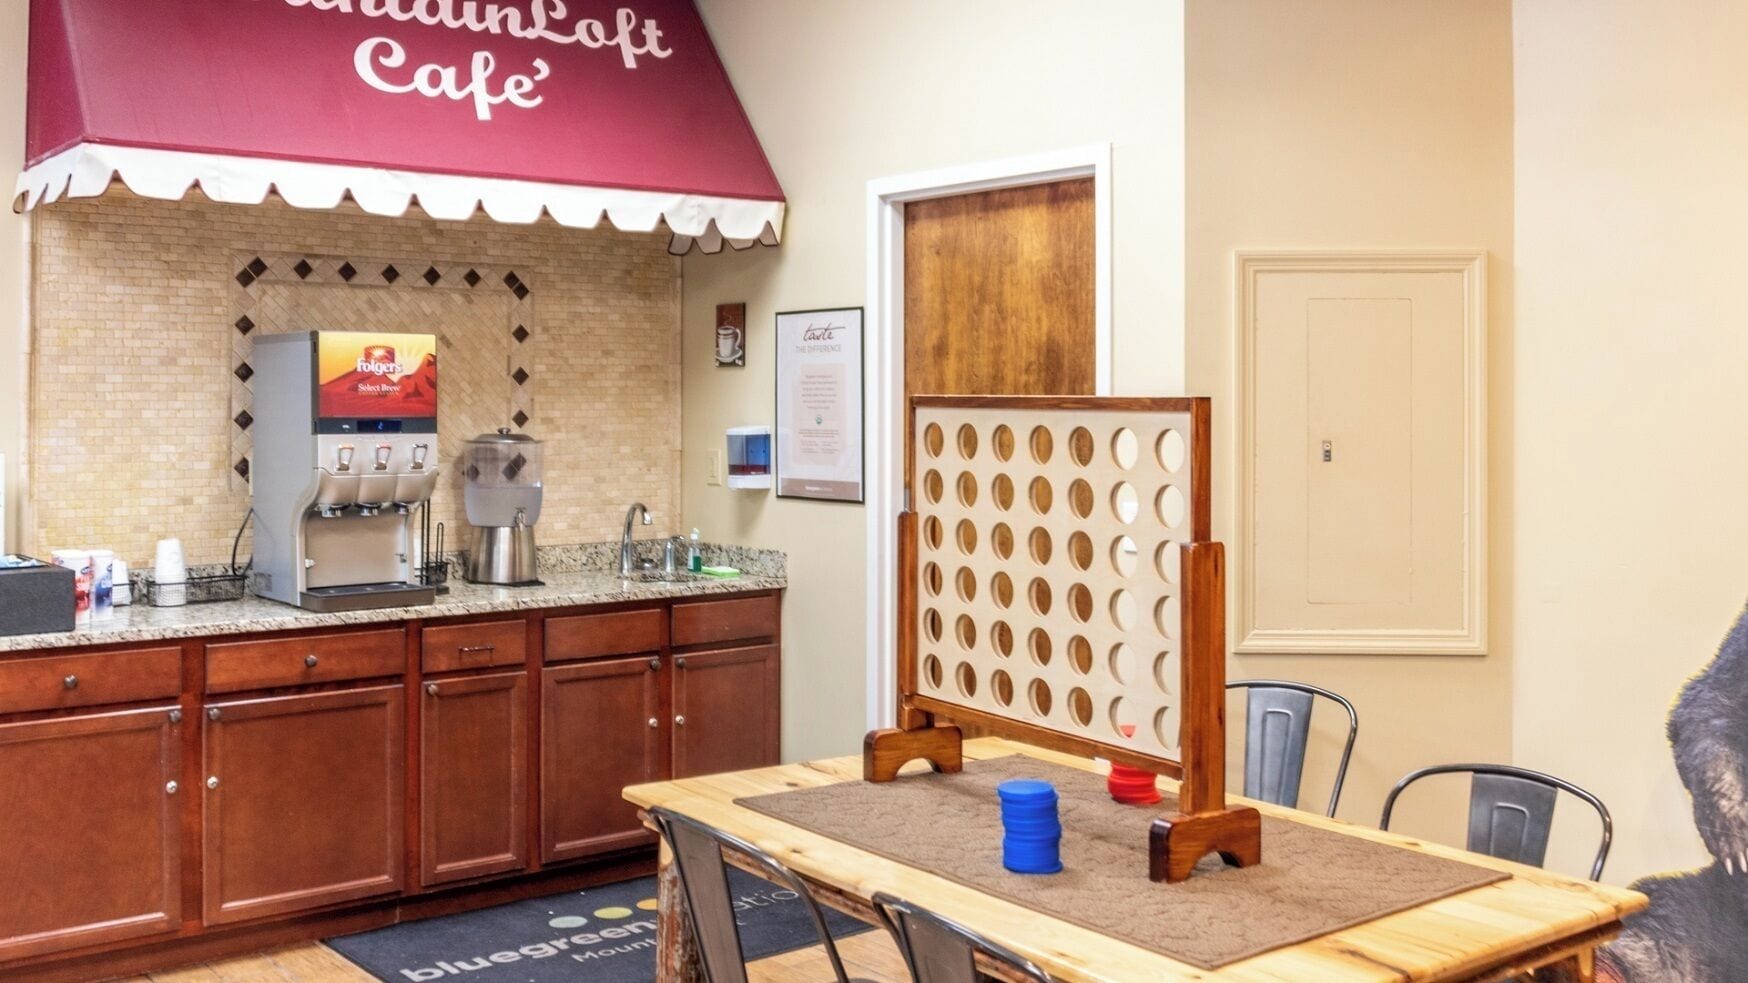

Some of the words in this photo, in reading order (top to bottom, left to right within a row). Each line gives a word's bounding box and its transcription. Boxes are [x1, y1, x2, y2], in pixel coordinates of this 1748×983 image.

[803, 322, 846, 342] taste
[808, 344, 842, 353] DIFFERENCE
[356, 357, 402, 375] Folgers
[358, 383, 380, 392] Select
[381, 383, 401, 392] Brew
